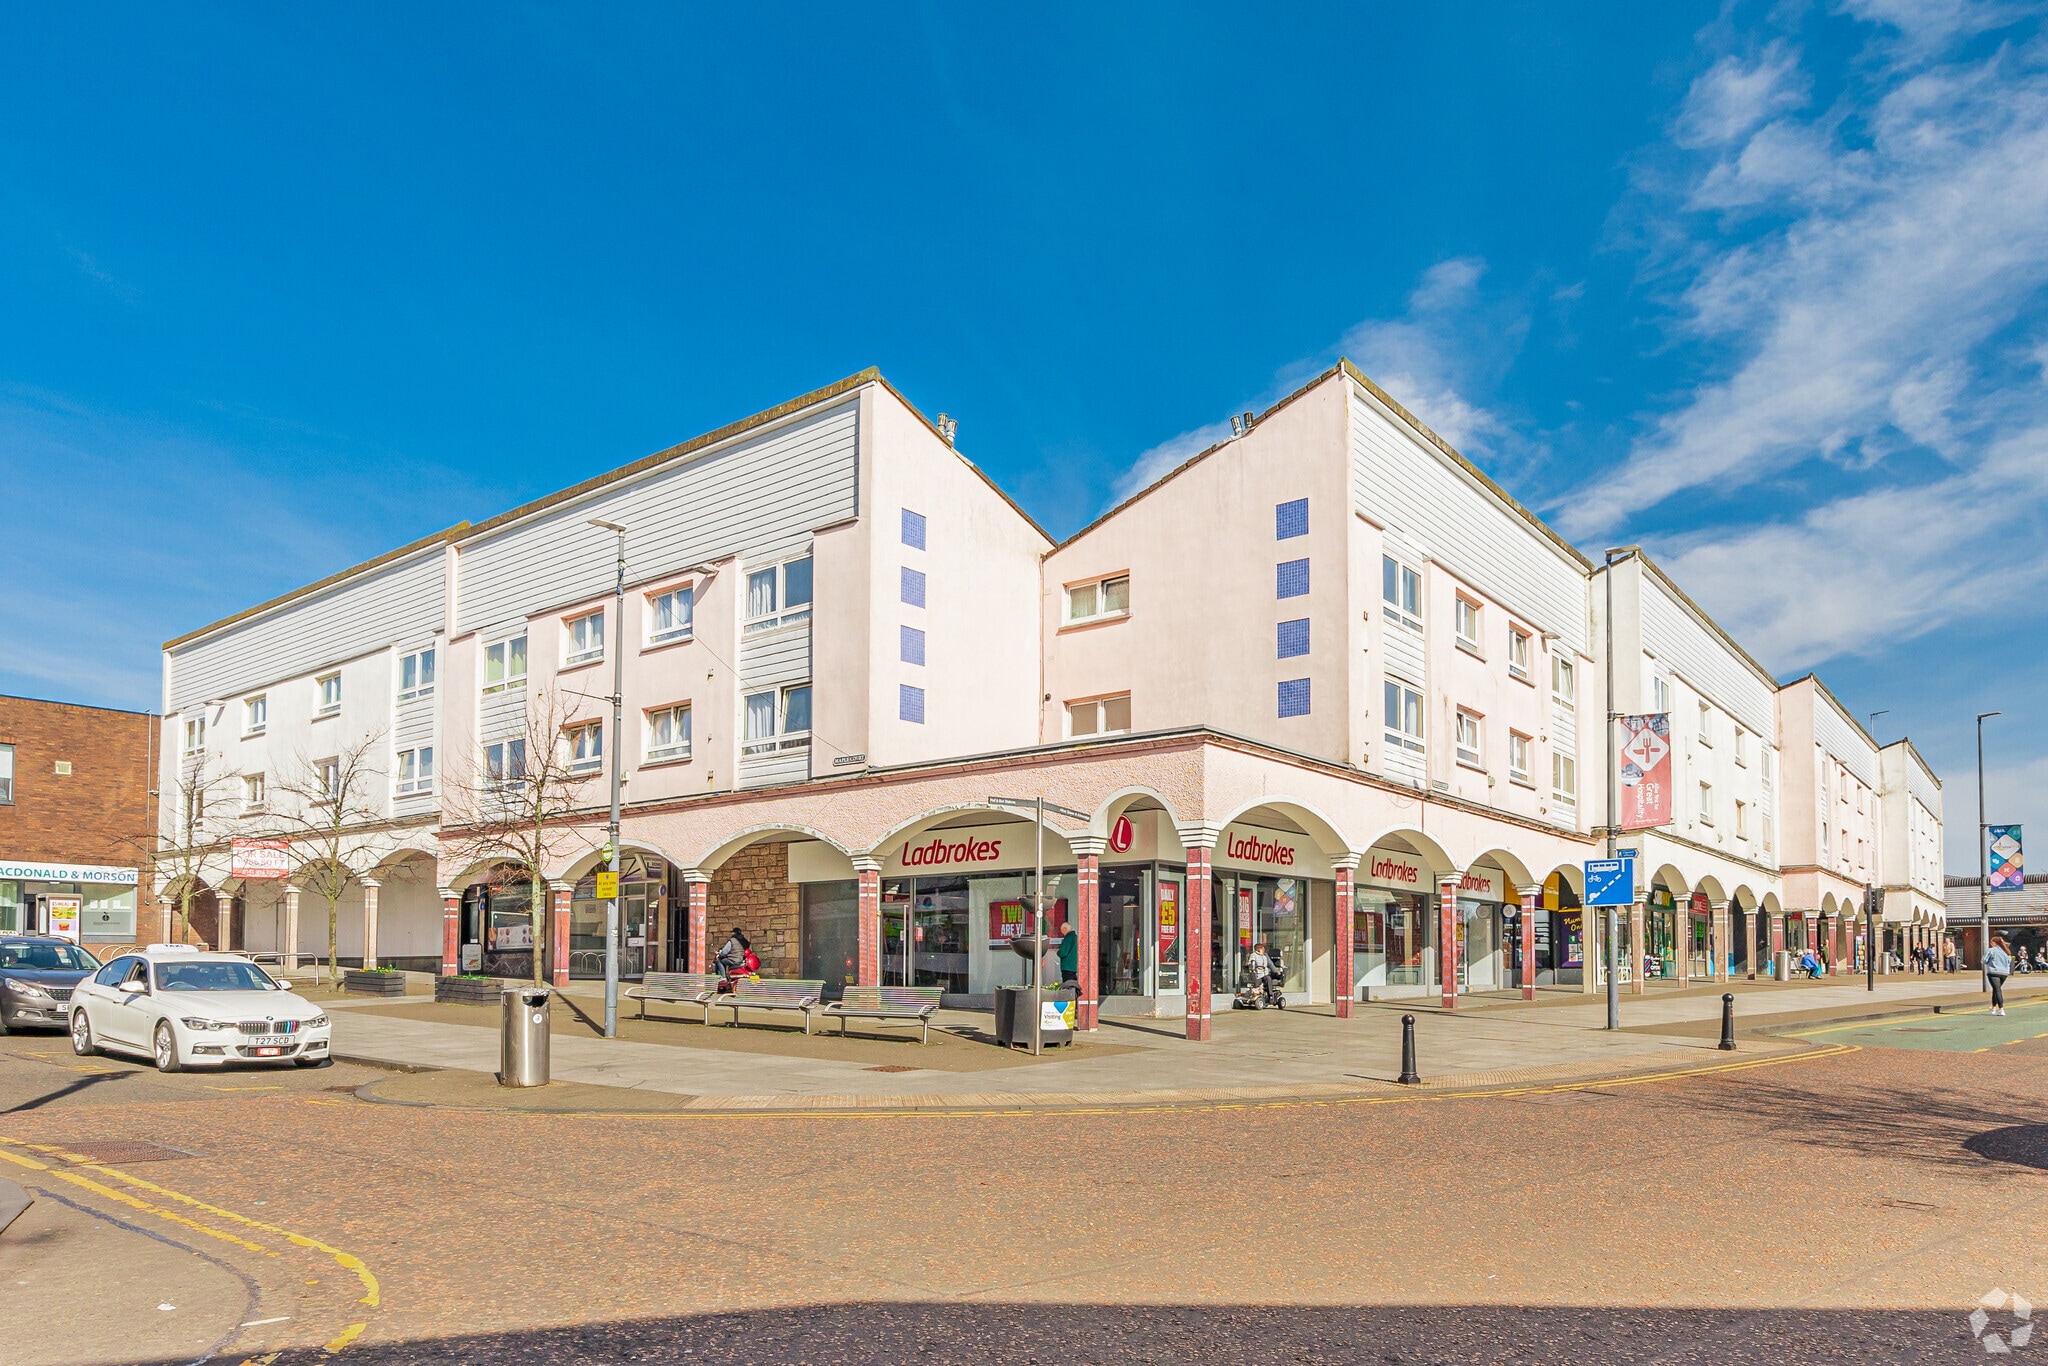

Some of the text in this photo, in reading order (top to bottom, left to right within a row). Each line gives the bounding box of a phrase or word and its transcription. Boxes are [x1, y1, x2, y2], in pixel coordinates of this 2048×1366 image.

[1636, 783, 1645, 818] Hospitality
[1646, 783, 1654, 805] Great
[260, 851, 285, 859] SALE
[902, 836, 1001, 866] Ladbrokes
[1227, 832, 1295, 865] Ladbrokes
[71, 871, 79, 879] &
[83, 871, 135, 882] MORSON
[1371, 855, 1418, 883] Ladbrokes
[1161, 889, 1174, 901] DAILY
[1161, 902, 1175, 926] £5
[1001, 924, 1015, 936] ARE
[255, 1037, 289, 1045] T27 SCD
